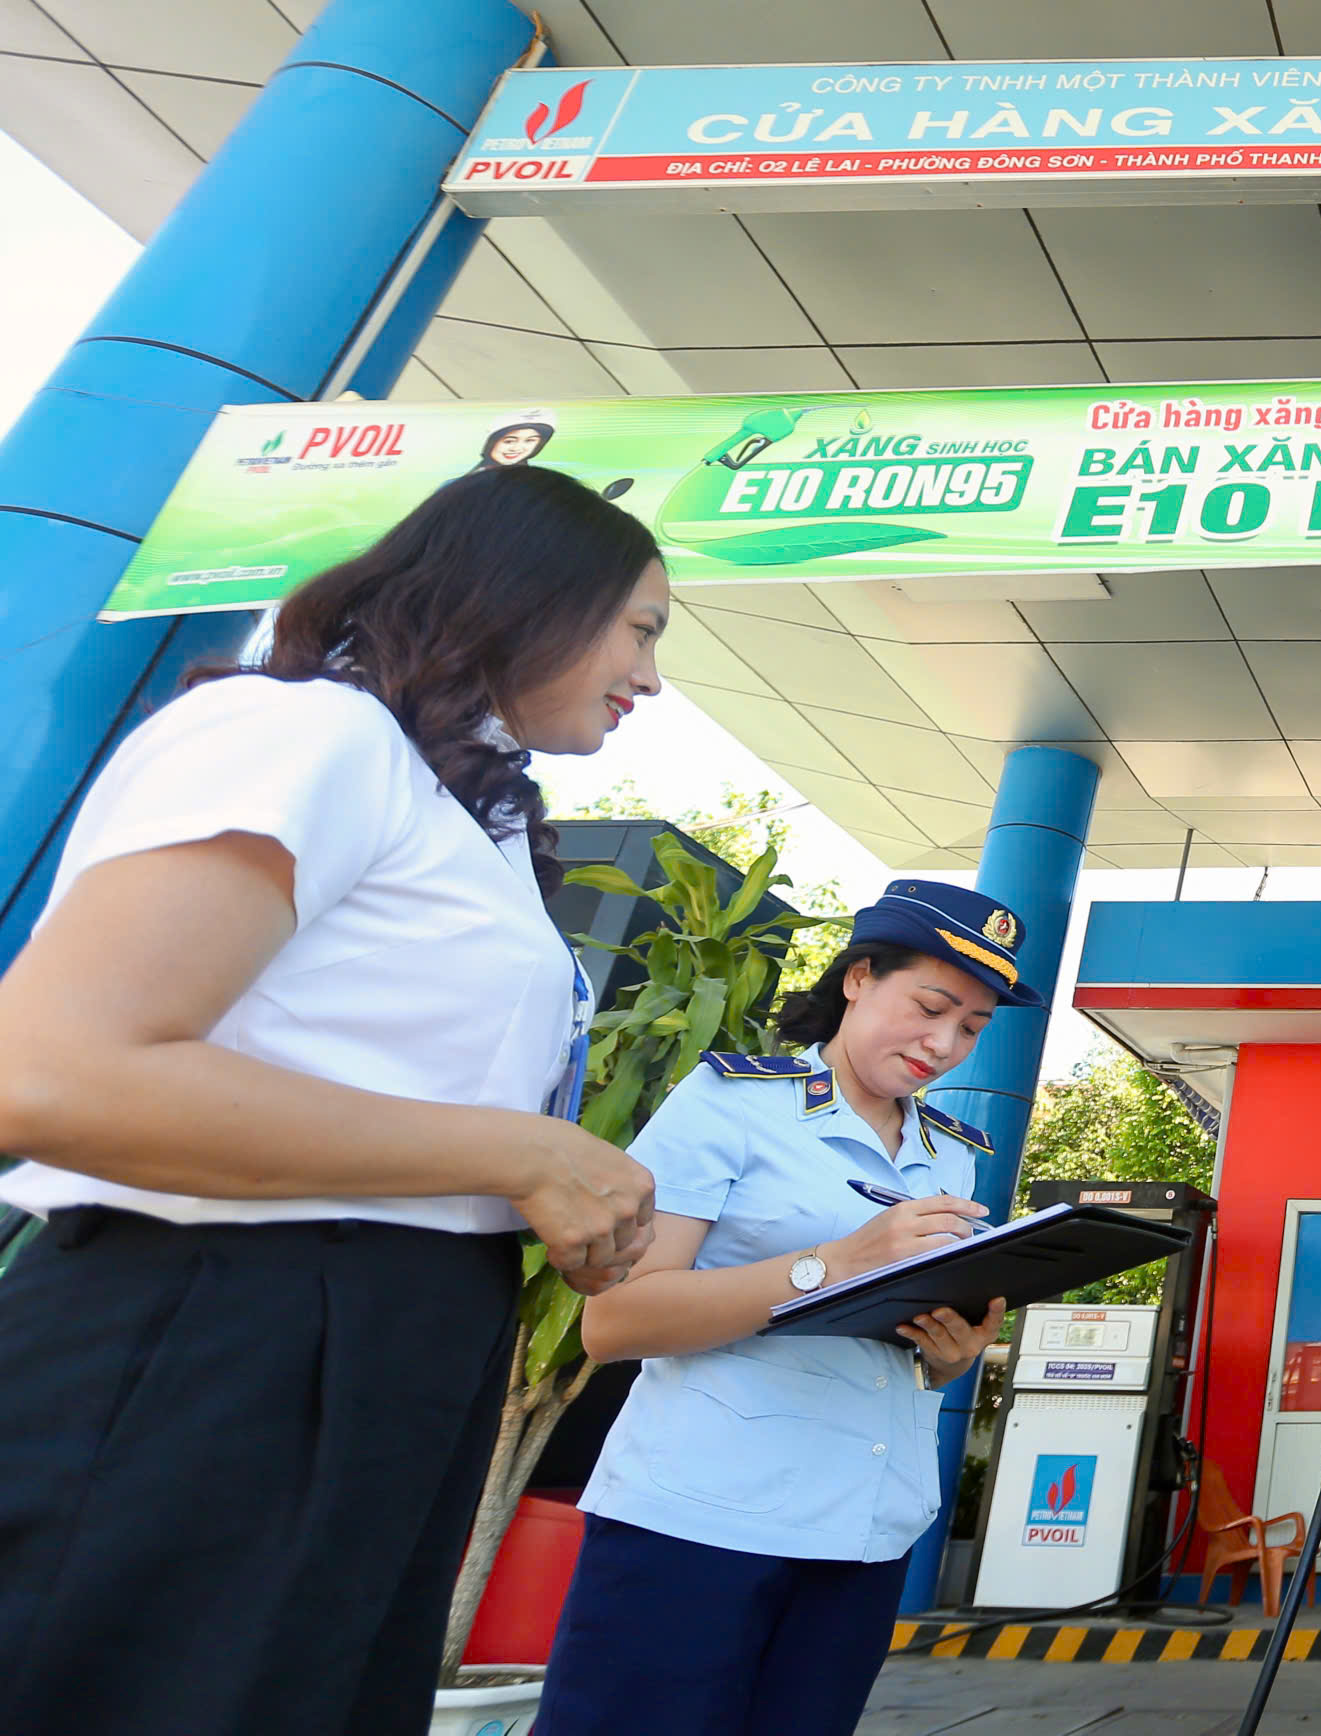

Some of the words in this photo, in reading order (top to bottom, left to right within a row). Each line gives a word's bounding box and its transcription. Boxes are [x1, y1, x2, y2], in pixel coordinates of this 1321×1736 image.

[811, 74, 903, 94] CÔNG
[913, 76, 954, 92] TY
[962, 75, 1048, 92] TNHH
[1056, 70, 1126, 92] MỘT
[1135, 69, 1241, 89] THÀNH
[687, 102, 873, 144] CỬA
[908, 102, 1174, 139] HÀNG
[464, 160, 573, 180] PVOIL
[666, 162, 702, 176] ĐỊA
[791, 157, 821, 172] LÊ
[824, 160, 860, 172] LAI
[878, 155, 971, 171] PHƯỜNG
[978, 153, 1041, 169] ĐÔNG
[1047, 154, 1096, 168] SƠN
[1115, 152, 1188, 167] THÀNH
[1196, 149, 1244, 165] PHỐ
[1090, 401, 1150, 431] Cửa
[1164, 400, 1242, 431] hàng
[298, 424, 406, 459] PVOIL
[926, 442, 977, 456] SINH
[981, 439, 1028, 456] HỌC
[1078, 440, 1199, 476] BÁN
[720, 468, 821, 513] E10
[825, 461, 1022, 510] RON95
[1060, 484, 1271, 540] E10
[1028, 1528, 1079, 1542] PVOIL
